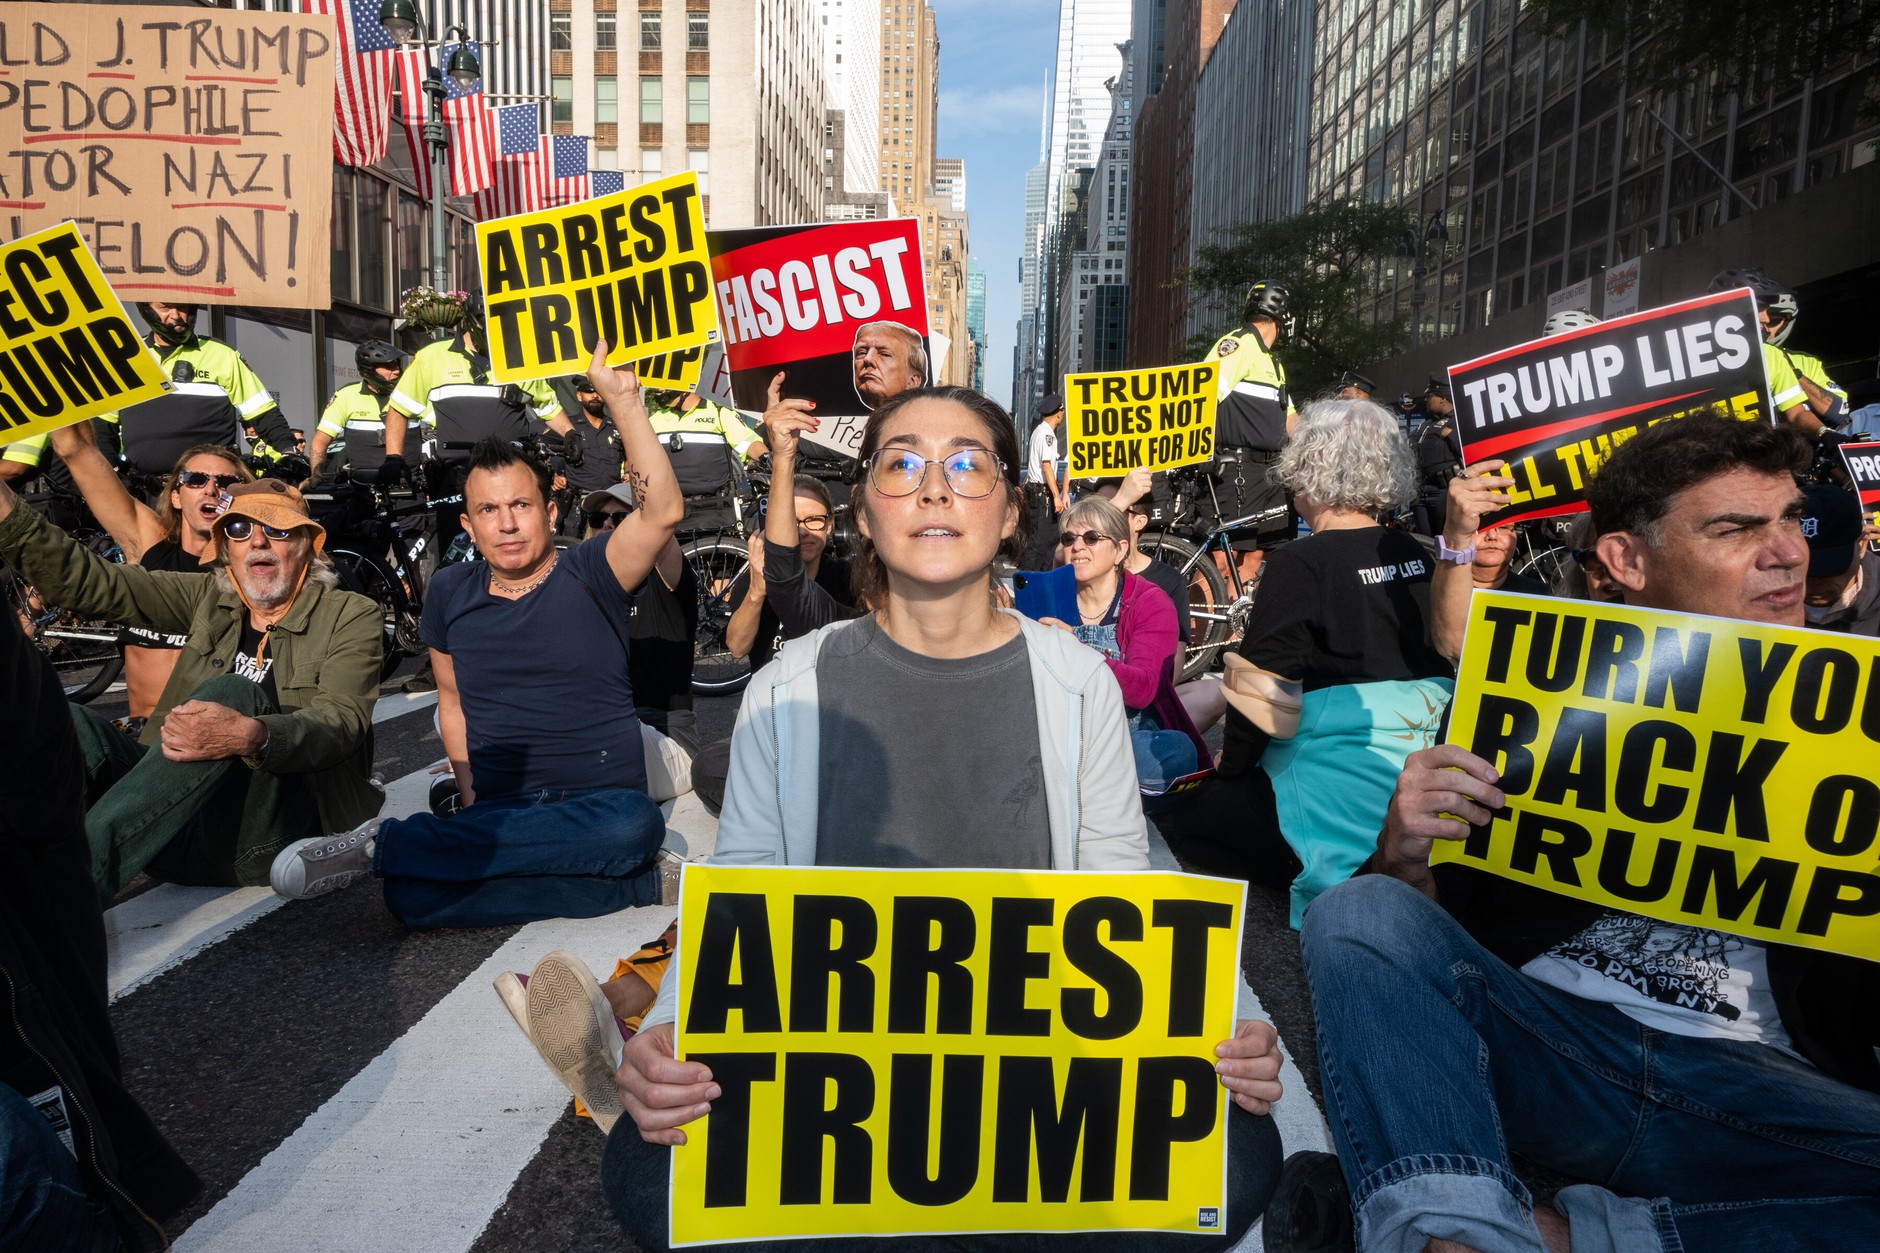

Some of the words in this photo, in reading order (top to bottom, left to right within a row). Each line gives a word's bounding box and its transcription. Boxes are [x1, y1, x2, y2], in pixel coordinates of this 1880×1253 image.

[0, 21, 71, 67] LD
[95, 17, 133, 68] J.
[142, 18, 330, 87] TRUMP
[0, 79, 282, 137] PEDOPHILE
[0, 144, 132, 199] TOR
[163, 146, 292, 199] NAZI
[487, 183, 696, 297] ARREST
[0, 232, 104, 340] ECT
[489, 260, 709, 370] TRUMP
[717, 236, 912, 345] FASCIST
[0, 316, 145, 432] RUMP
[1073, 366, 1213, 405] TRUMP
[1463, 344, 1625, 428] TRUMP
[1636, 315, 1750, 388] LIES
[695, 416, 716, 425] POLICE
[830, 416, 864, 451] Pre
[1072, 438, 1143, 471] SPEAK
[1148, 432, 1184, 467] FOR
[1187, 426, 1212, 458] US
[1081, 405, 1153, 437] DOES
[1159, 396, 1207, 431] NOT
[1480, 455, 1557, 509] LL
[1848, 454, 1880, 482] PR
[1358, 564, 1397, 585] TRUMP
[1398, 559, 1426, 578] LIES
[1484, 605, 1711, 714] TURN
[1471, 693, 1790, 843] BACK
[1804, 773, 1880, 860] O
[1463, 806, 1880, 938] TRUMP
[685, 892, 1234, 1041] ARREST
[1603, 959, 1649, 995] PM
[685, 1052, 1218, 1208] TRUMP
